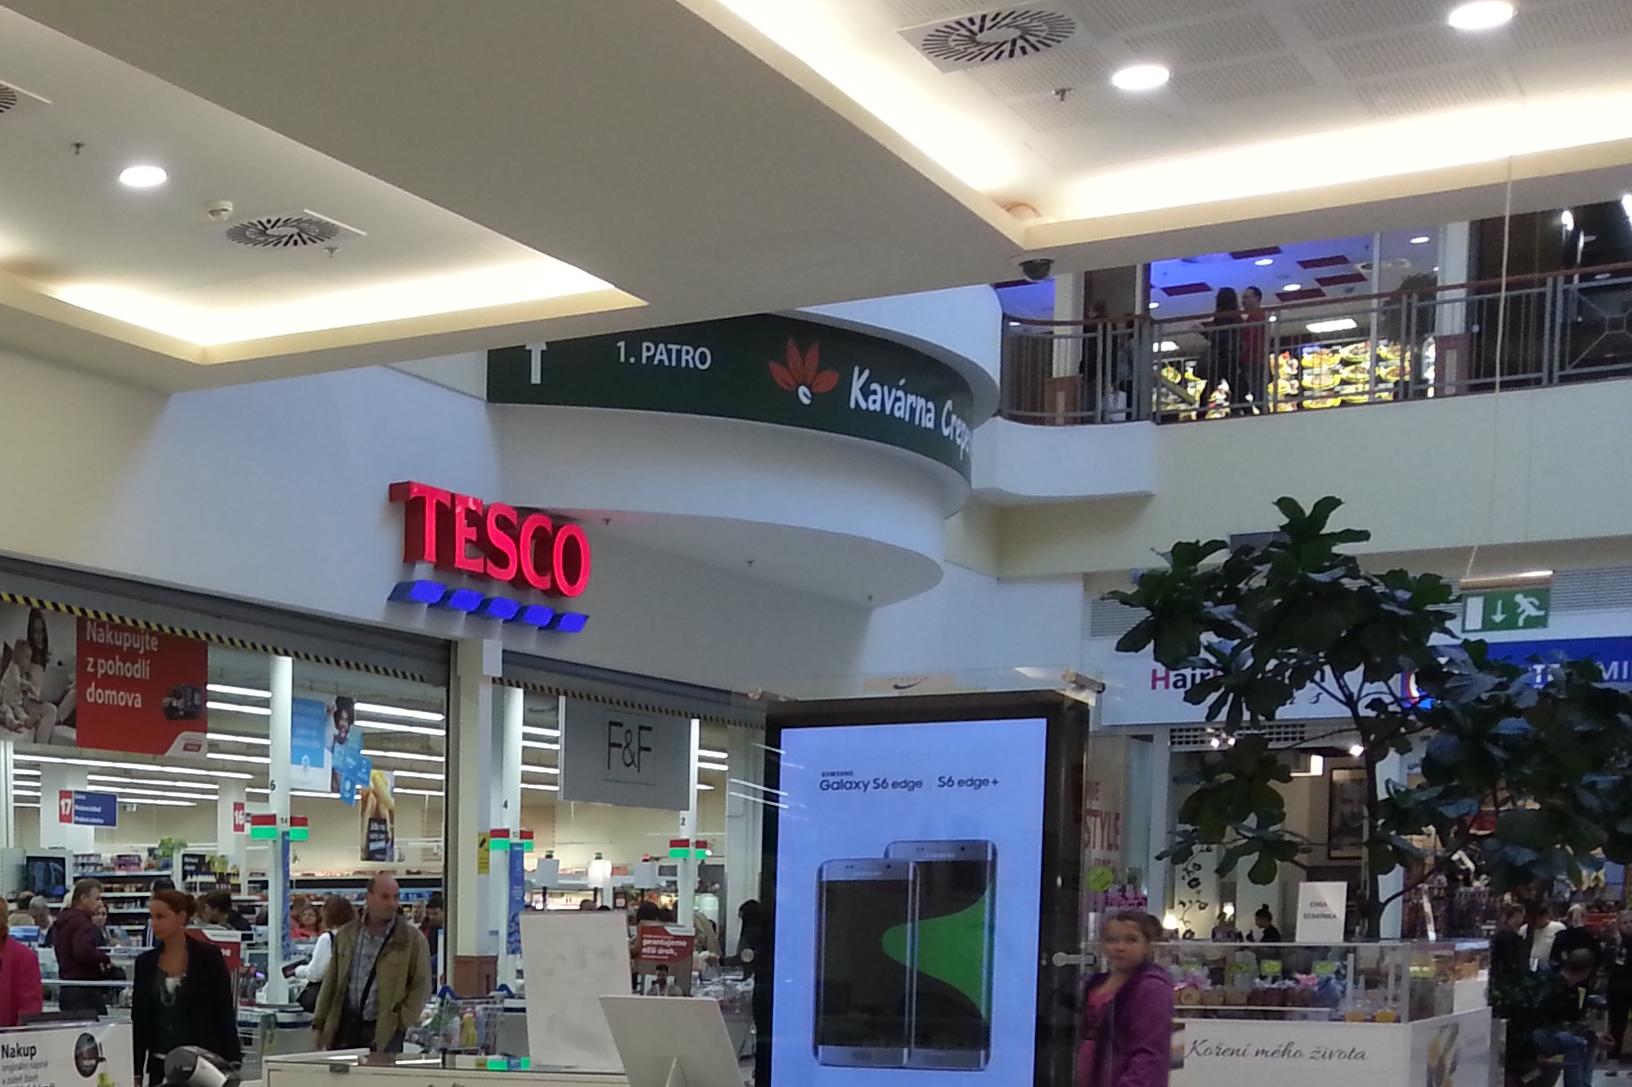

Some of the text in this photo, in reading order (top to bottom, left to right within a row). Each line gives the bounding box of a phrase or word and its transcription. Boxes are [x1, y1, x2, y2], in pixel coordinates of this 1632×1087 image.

[616, 340, 713, 371] 1. PATRO
[849, 365, 936, 430] Kavárna
[389, 480, 592, 598] TESCO
[86, 620, 159, 654] Nakupujte
[87, 654, 151, 680] z pohodlí
[86, 681, 142, 708] domova
[607, 720, 653, 774] F&F
[819, 778, 870, 793] Galaxy
[872, 777, 890, 790] S6
[891, 778, 924, 792] edge
[937, 775, 956, 789] S6
[60, 798, 72, 816] 17
[1, 1041, 37, 1061] Nakup
[1184, 1039, 1367, 1062] Koření mého života
